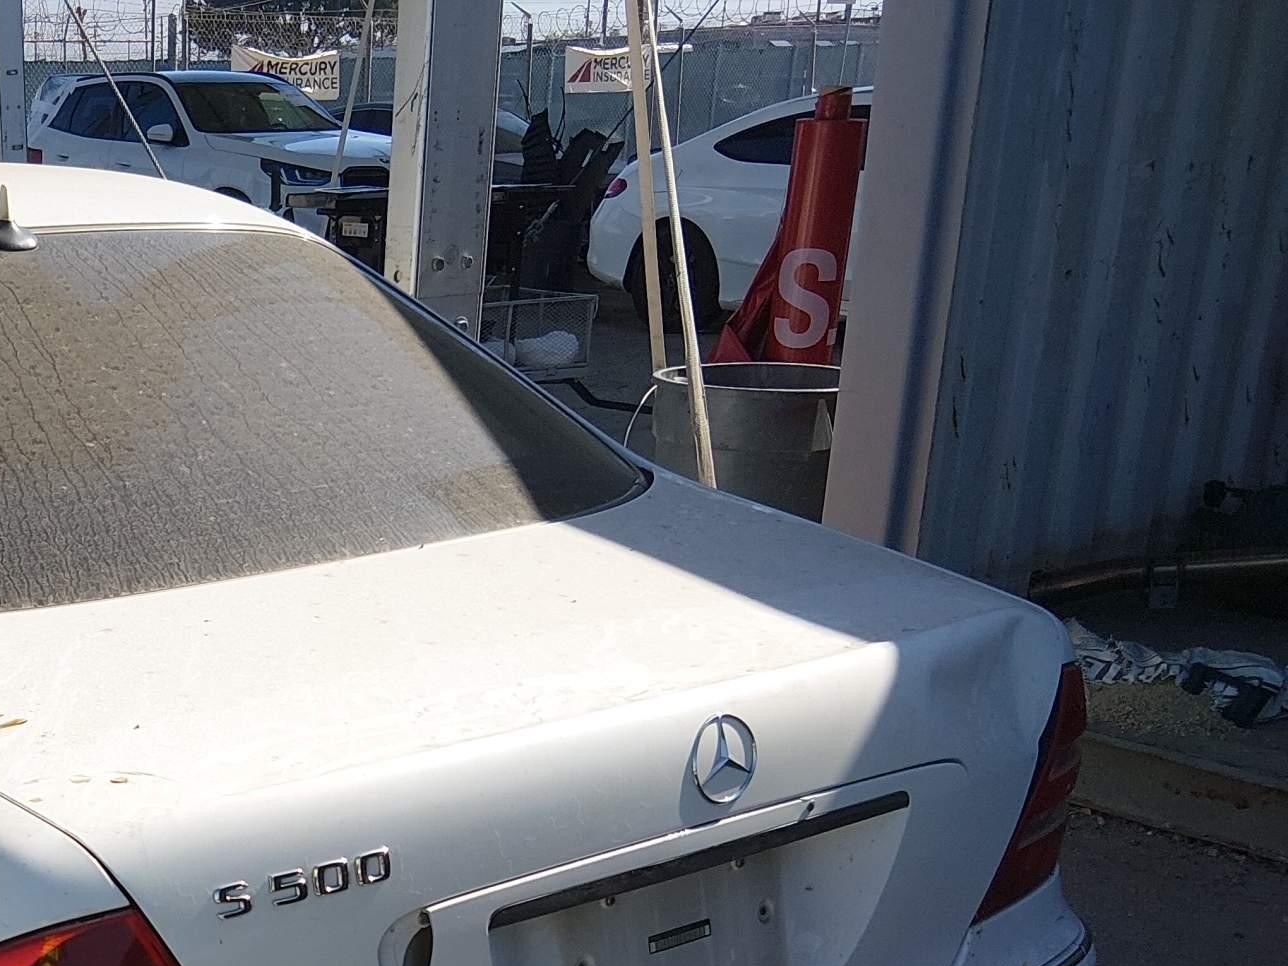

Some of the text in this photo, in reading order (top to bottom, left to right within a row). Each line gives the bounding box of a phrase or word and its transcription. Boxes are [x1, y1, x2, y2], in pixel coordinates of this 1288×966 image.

[266, 60, 337, 76] MERCURY
[594, 54, 649, 71] MERCY
[213, 845, 391, 920] S 500
